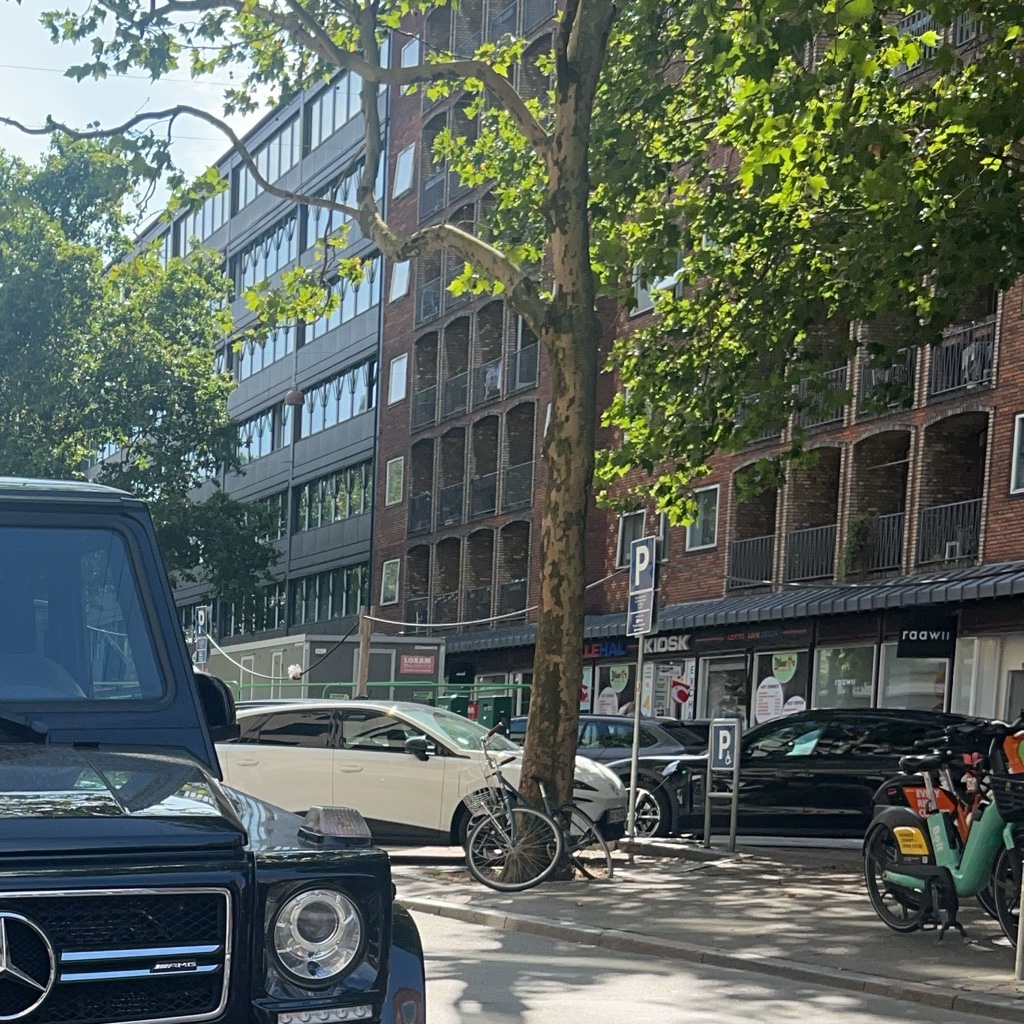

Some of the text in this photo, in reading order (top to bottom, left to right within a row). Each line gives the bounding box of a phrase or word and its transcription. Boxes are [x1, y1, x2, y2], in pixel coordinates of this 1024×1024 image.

[635, 545, 650, 586] P
[643, 634, 691, 654] KIOSK
[718, 729, 731, 760] P
